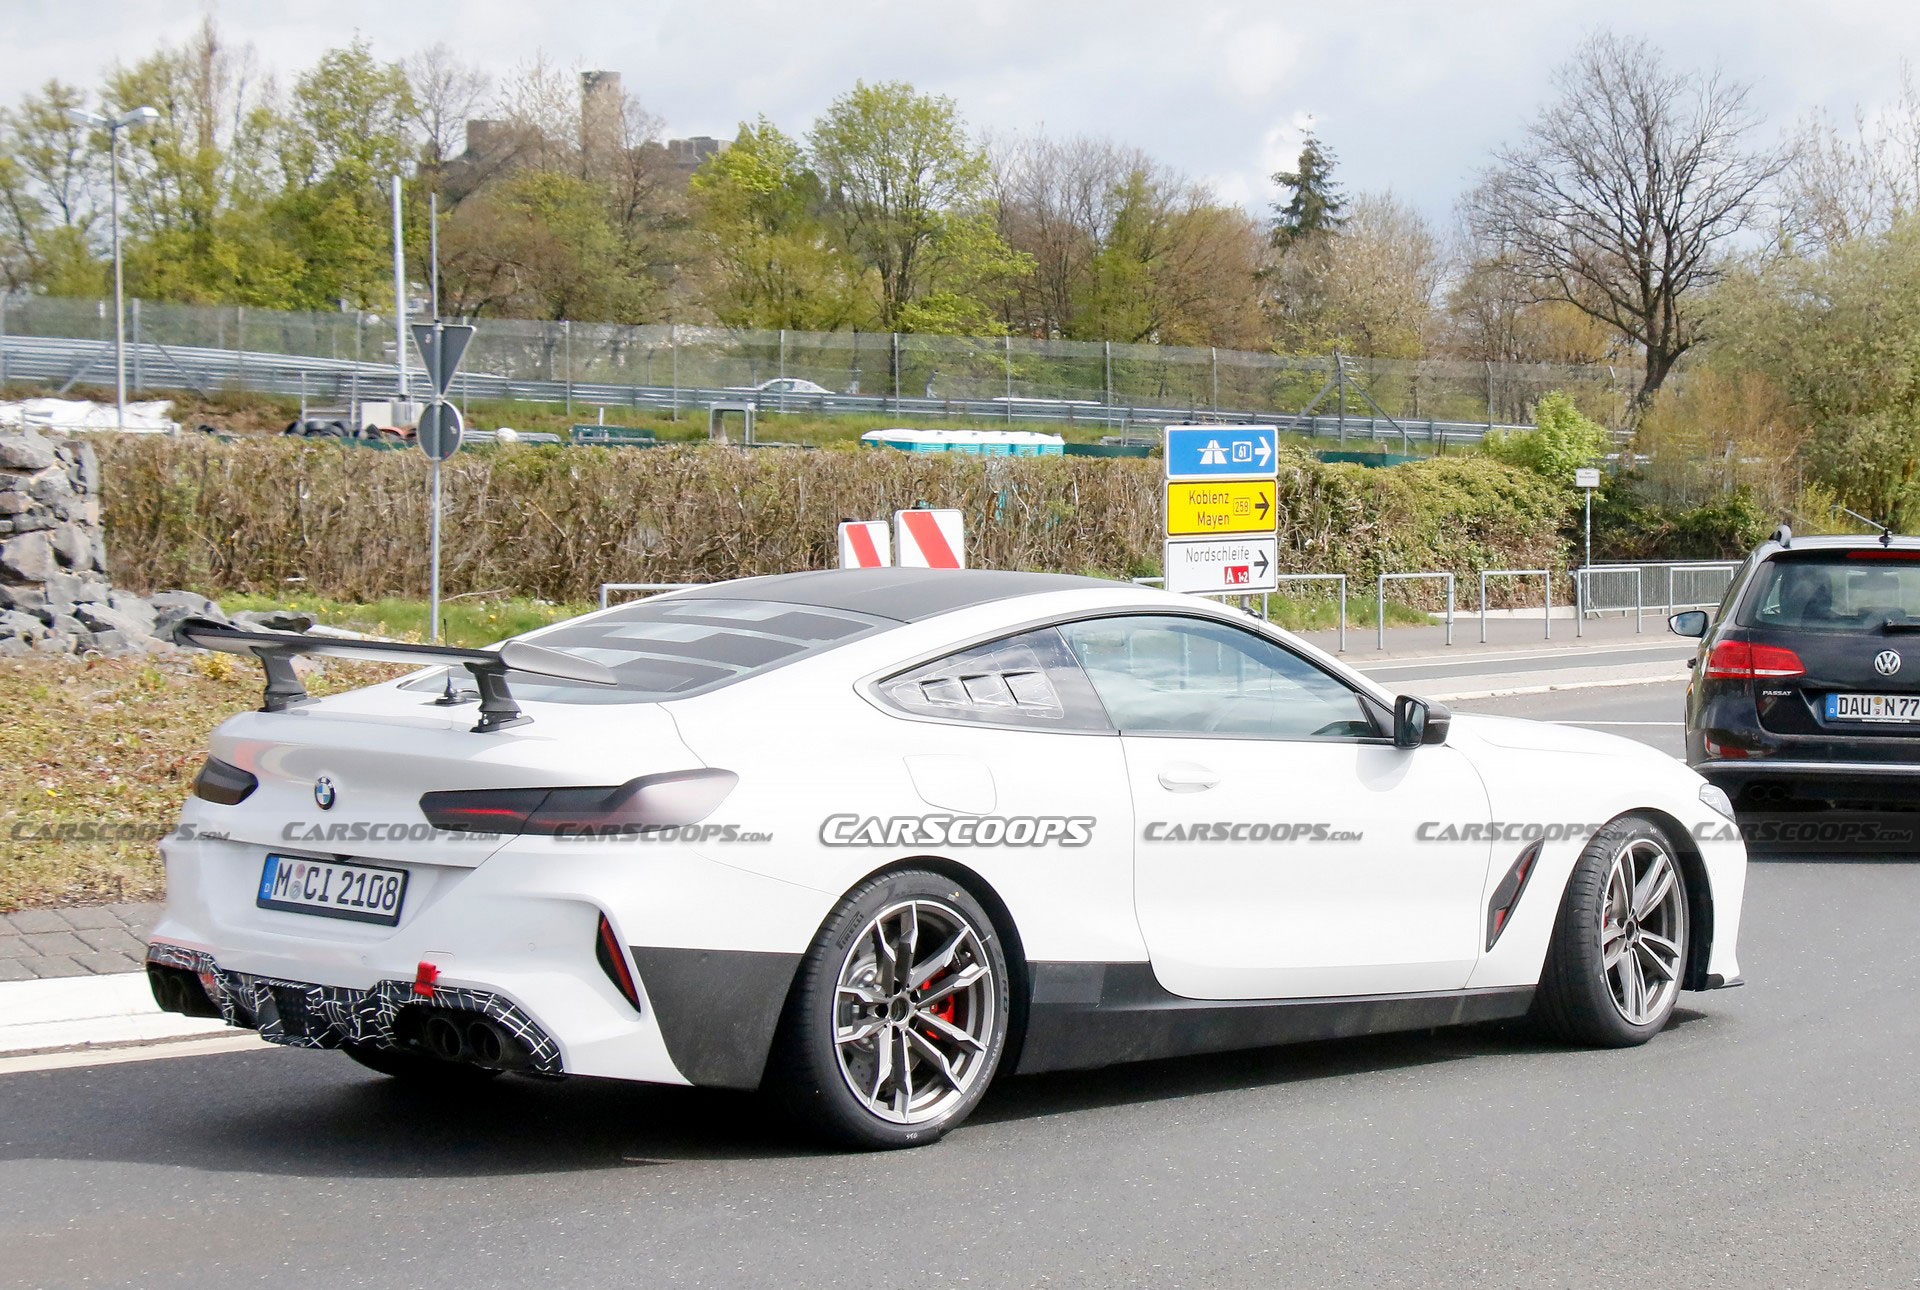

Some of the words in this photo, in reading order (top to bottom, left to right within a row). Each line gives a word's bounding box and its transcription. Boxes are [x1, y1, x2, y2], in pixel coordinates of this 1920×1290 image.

[1238, 445, 1247, 458] 61
[1188, 489, 1230, 505] Koblenz
[1235, 501, 1249, 513] 258
[1197, 511, 1230, 530] Mayen
[1185, 546, 1250, 563] Nordschleife
[1225, 567, 1235, 584] A
[1838, 697, 1871, 716] DAU
[1884, 697, 1895, 716] N
[1899, 698, 1920, 717] 77
[263, 882, 271, 893] D
[273, 862, 293, 897] M
[303, 866, 333, 902] CI
[336, 870, 399, 911] 2108
